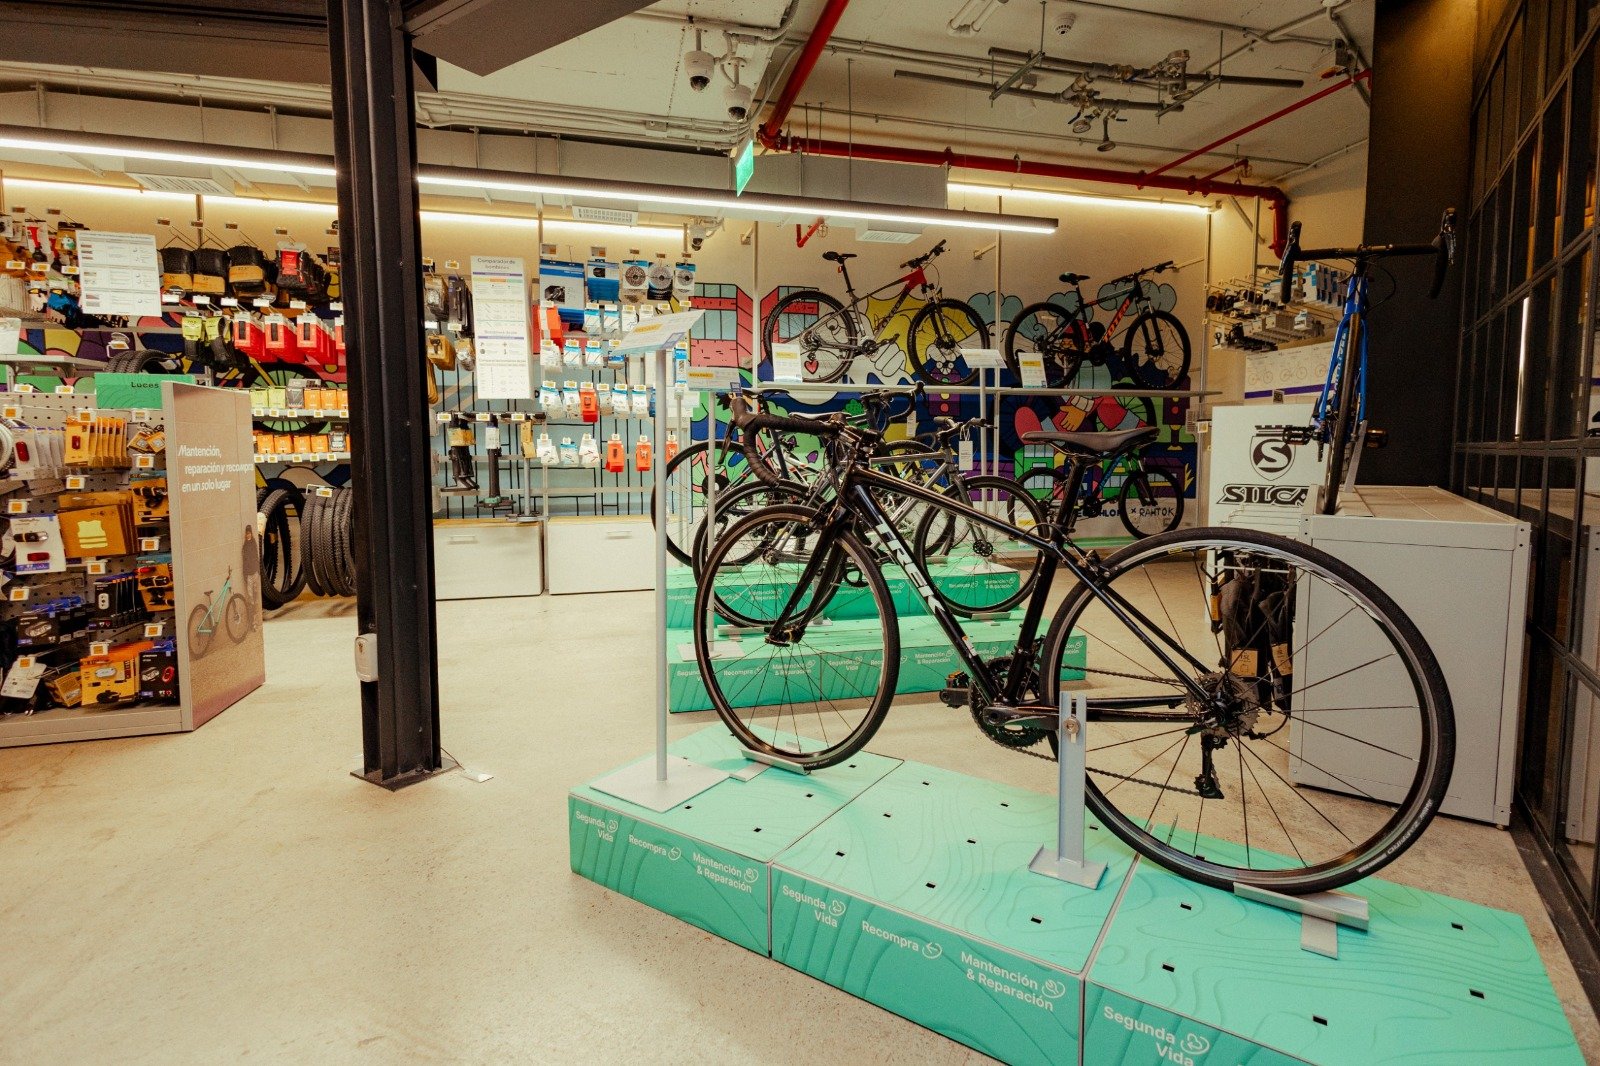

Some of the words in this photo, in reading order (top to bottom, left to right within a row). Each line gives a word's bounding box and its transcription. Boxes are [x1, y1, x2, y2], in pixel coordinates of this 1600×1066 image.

[131, 381, 159, 389] Luces
[184, 462, 220, 476] reparación
[182, 483, 191, 492] en
[191, 482, 201, 491] un
[201, 479, 215, 491] solo
[215, 479, 232, 490] lugar
[875, 514, 946, 614] TREK
[576, 810, 605, 829] Segunda
[597, 828, 614, 842] Vida
[628, 834, 667, 856] Recompra
[692, 851, 742, 878] Mantención
[696, 865, 703, 875] &
[704, 868, 752, 893] Reparación
[782, 885, 826, 910] Segunda
[814, 910, 838, 928] Vida
[862, 920, 919, 951] Recompra
[961, 951, 1038, 990] Mantención
[966, 968, 975, 981] &
[978, 972, 1054, 1012] Reparación
[1103, 1006, 1176, 1045] Segunda
[1156, 1042, 1194, 1066] Vida
